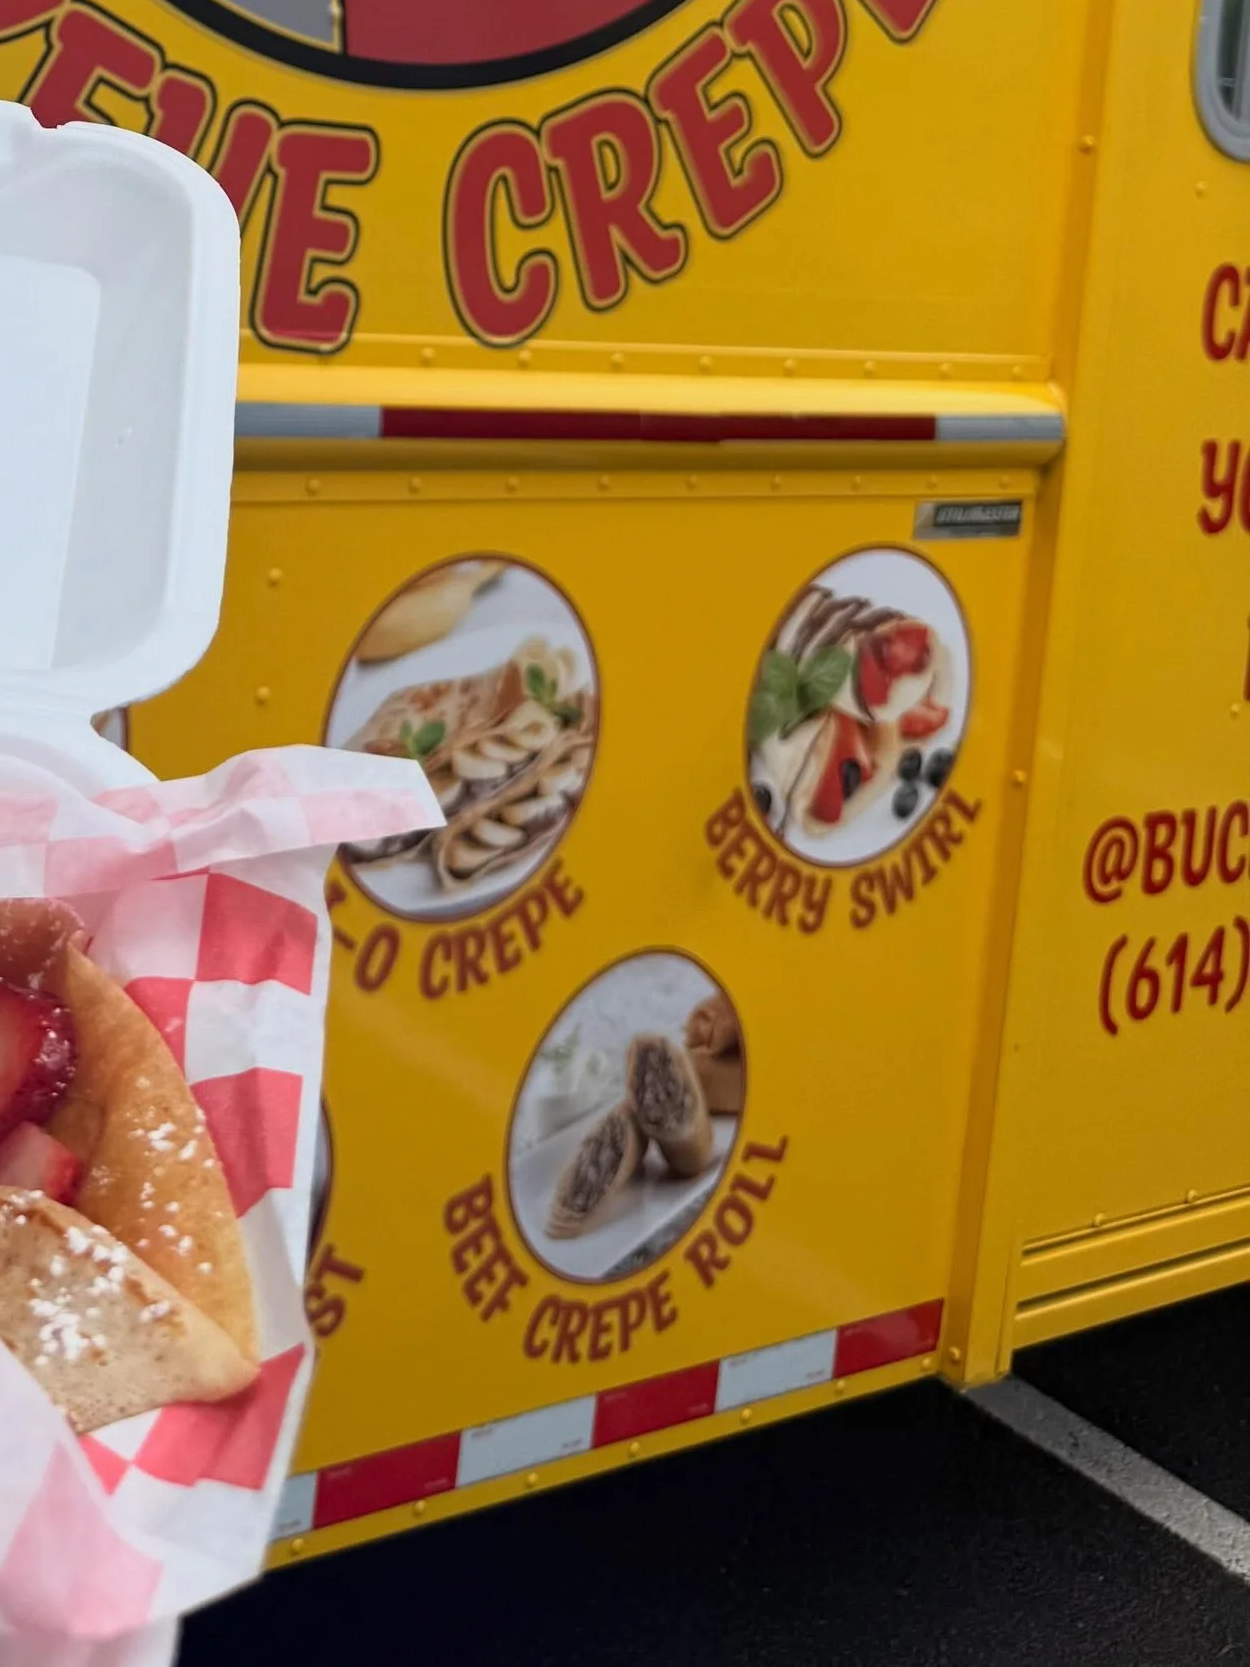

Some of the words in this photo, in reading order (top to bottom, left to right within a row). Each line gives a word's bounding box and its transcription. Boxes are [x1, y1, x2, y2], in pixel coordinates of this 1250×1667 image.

[704, 787, 832, 935] BERRY
[849, 787, 982, 930] SWIRL
[1082, 799, 1250, 905] @BUC
[418, 858, 584, 1001] CREPE
[1098, 915, 1250, 1036] (614)
[443, 1172, 530, 1323] BEEF
[522, 1270, 678, 1364] CREPE
[682, 1135, 788, 1289] ROLL
